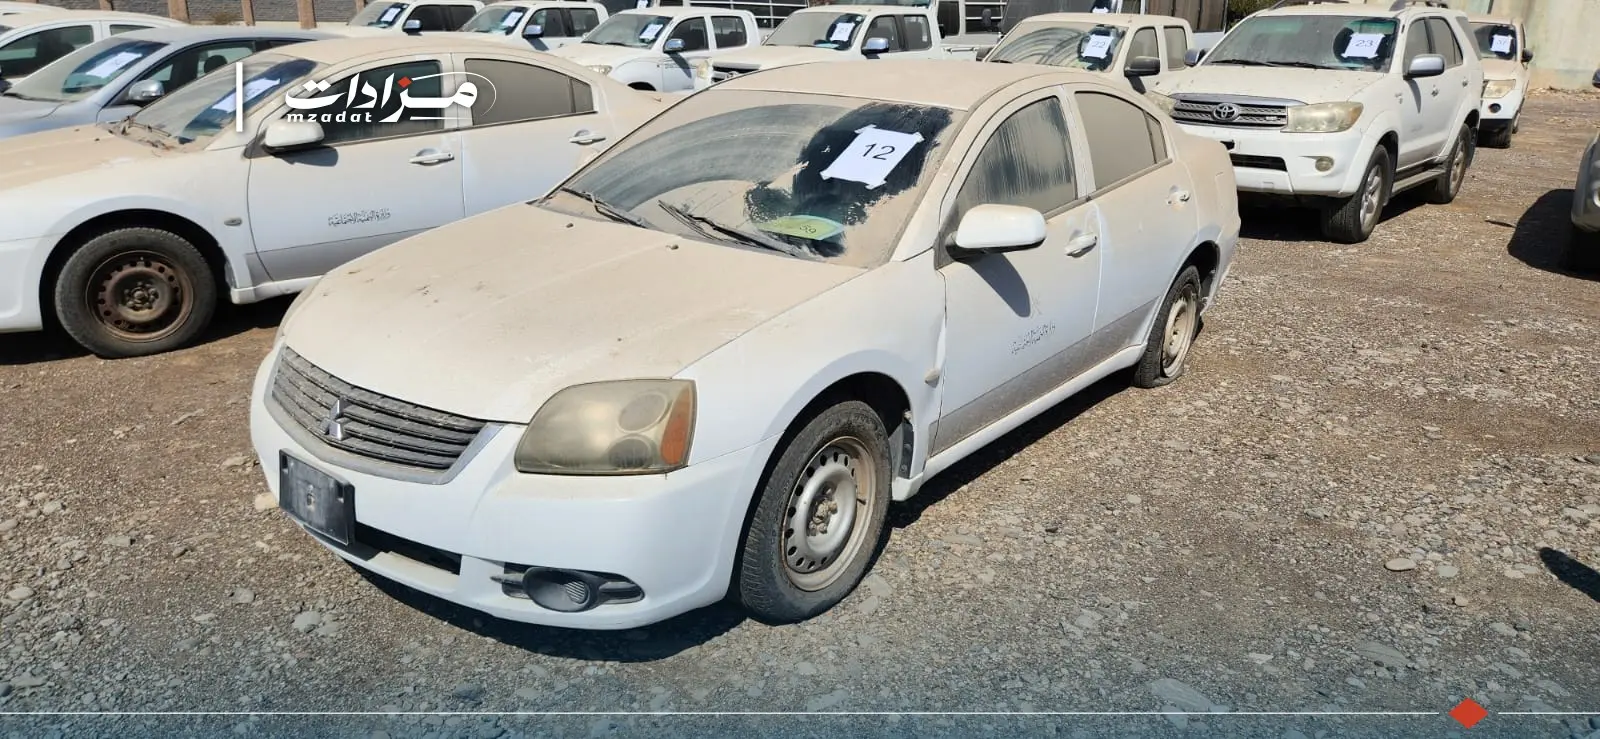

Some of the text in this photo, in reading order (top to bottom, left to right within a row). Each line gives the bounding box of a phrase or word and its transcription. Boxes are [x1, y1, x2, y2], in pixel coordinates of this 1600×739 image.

[1091, 40, 1106, 49] 22
[1354, 39, 1374, 48] 23
[862, 143, 896, 160] 12
